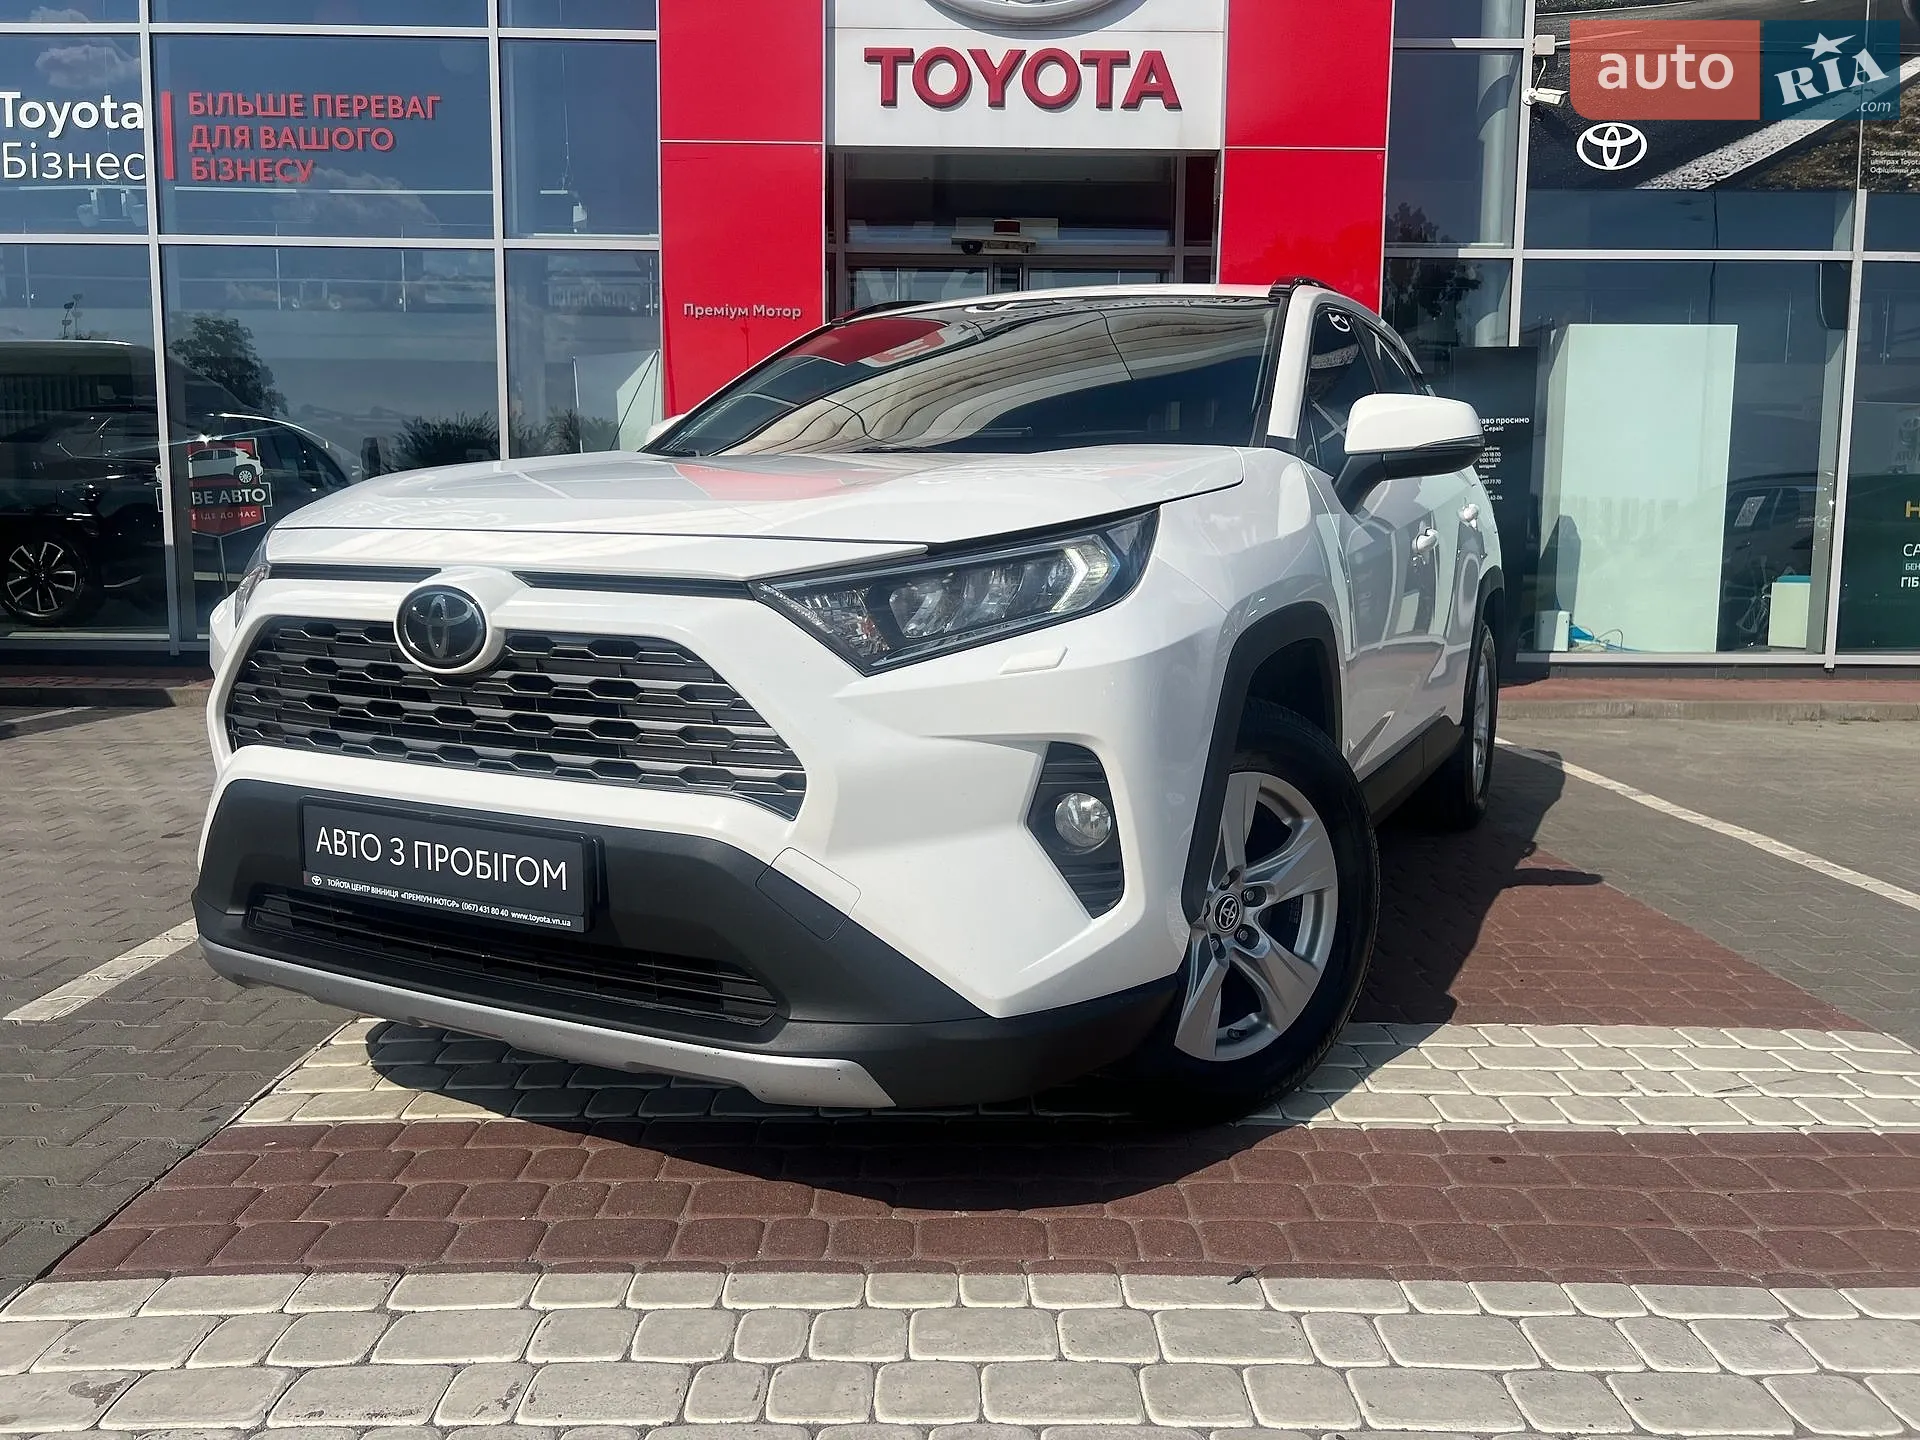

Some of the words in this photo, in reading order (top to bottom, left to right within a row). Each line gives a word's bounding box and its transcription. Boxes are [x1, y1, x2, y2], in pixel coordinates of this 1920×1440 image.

[864, 46, 1182, 112] TOYOTA
[0, 91, 144, 139] Toyota
[188, 92, 305, 119] БІЛЬШЕ
[313, 95, 441, 121] ПЕРЕВАГ
[188, 125, 251, 152] ДЛЯ
[259, 126, 395, 153] ВАШОГО
[2, 141, 147, 181] Бізнес
[190, 157, 315, 183] БІЗНЕСУ
[683, 303, 748, 320] Преміум
[752, 304, 802, 321] Мотор
[1495, 417, 1530, 426] просимо
[191, 490, 214, 505] ВЕ
[218, 488, 267, 504] АВТО
[315, 826, 382, 863] АВТО
[413, 839, 568, 892] ПРОБІГОМ
[326, 878, 350, 890] ТОЙОТА
[351, 883, 371, 893] ЦЕНТР
[371, 886, 399, 899] ВІННИЦЯ
[400, 891, 433, 904] «ПРЕМІУМ
[433, 897, 460, 909] МОТОР»
[461, 901, 479, 913] (067)
[479, 905, 490, 914] 431
[490, 908, 499, 916] 80
[500, 908, 509, 917] 40
[511, 911, 572, 928] www.toyota.vn.ua
